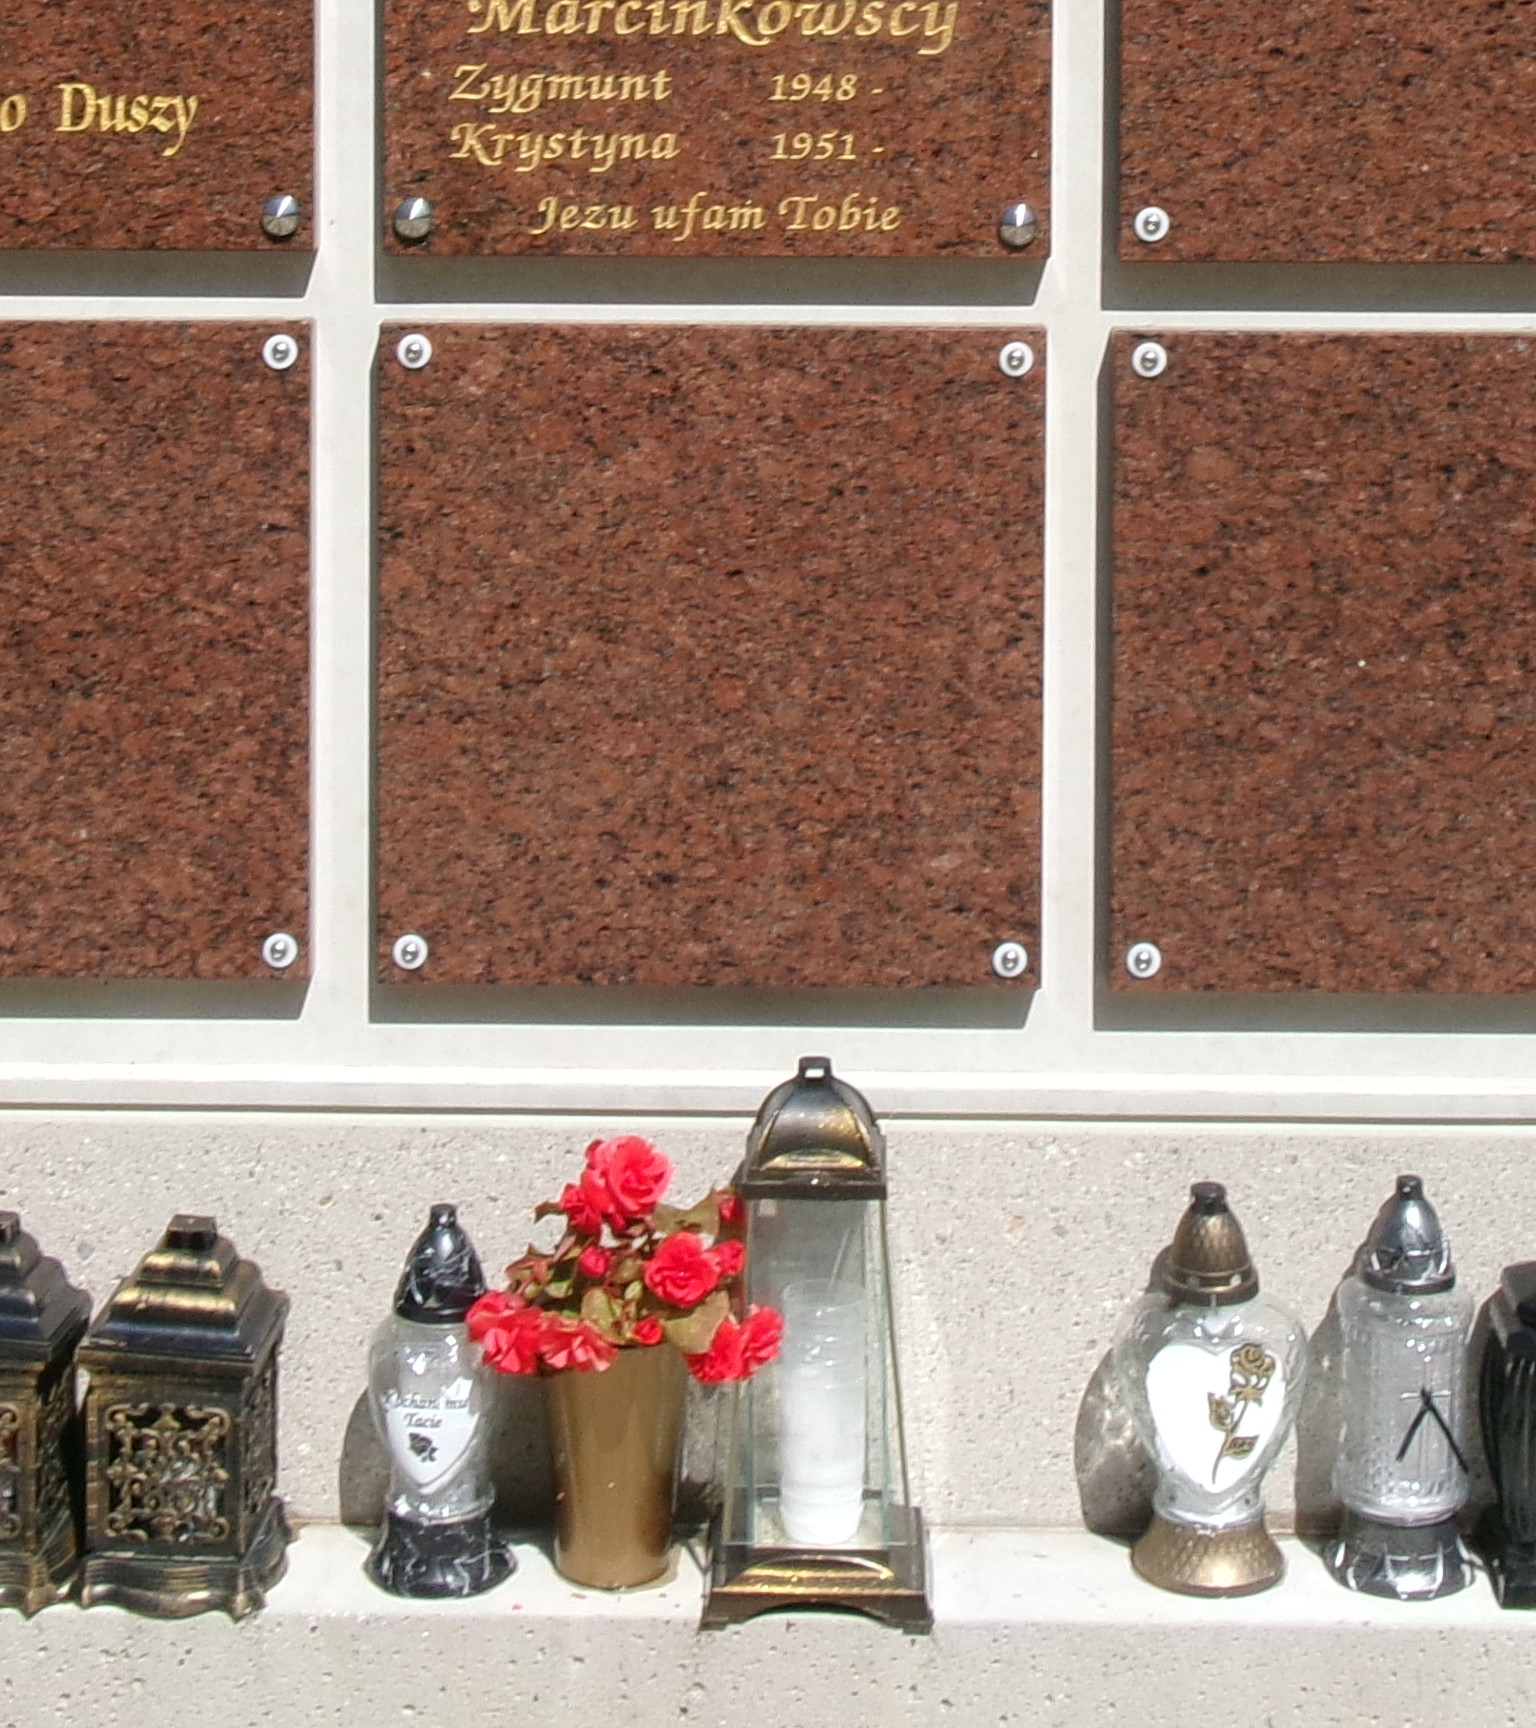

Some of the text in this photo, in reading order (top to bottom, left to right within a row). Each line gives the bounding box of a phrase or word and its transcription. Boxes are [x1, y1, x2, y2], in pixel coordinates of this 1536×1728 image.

[448, 63, 673, 114] Zygmunt
[768, 72, 857, 102] 1948
[56, 83, 199, 156] Duszy
[448, 121, 680, 172] Krystyna
[769, 131, 857, 160] 1951
[530, 191, 902, 242] Jezu ufam Tobie
